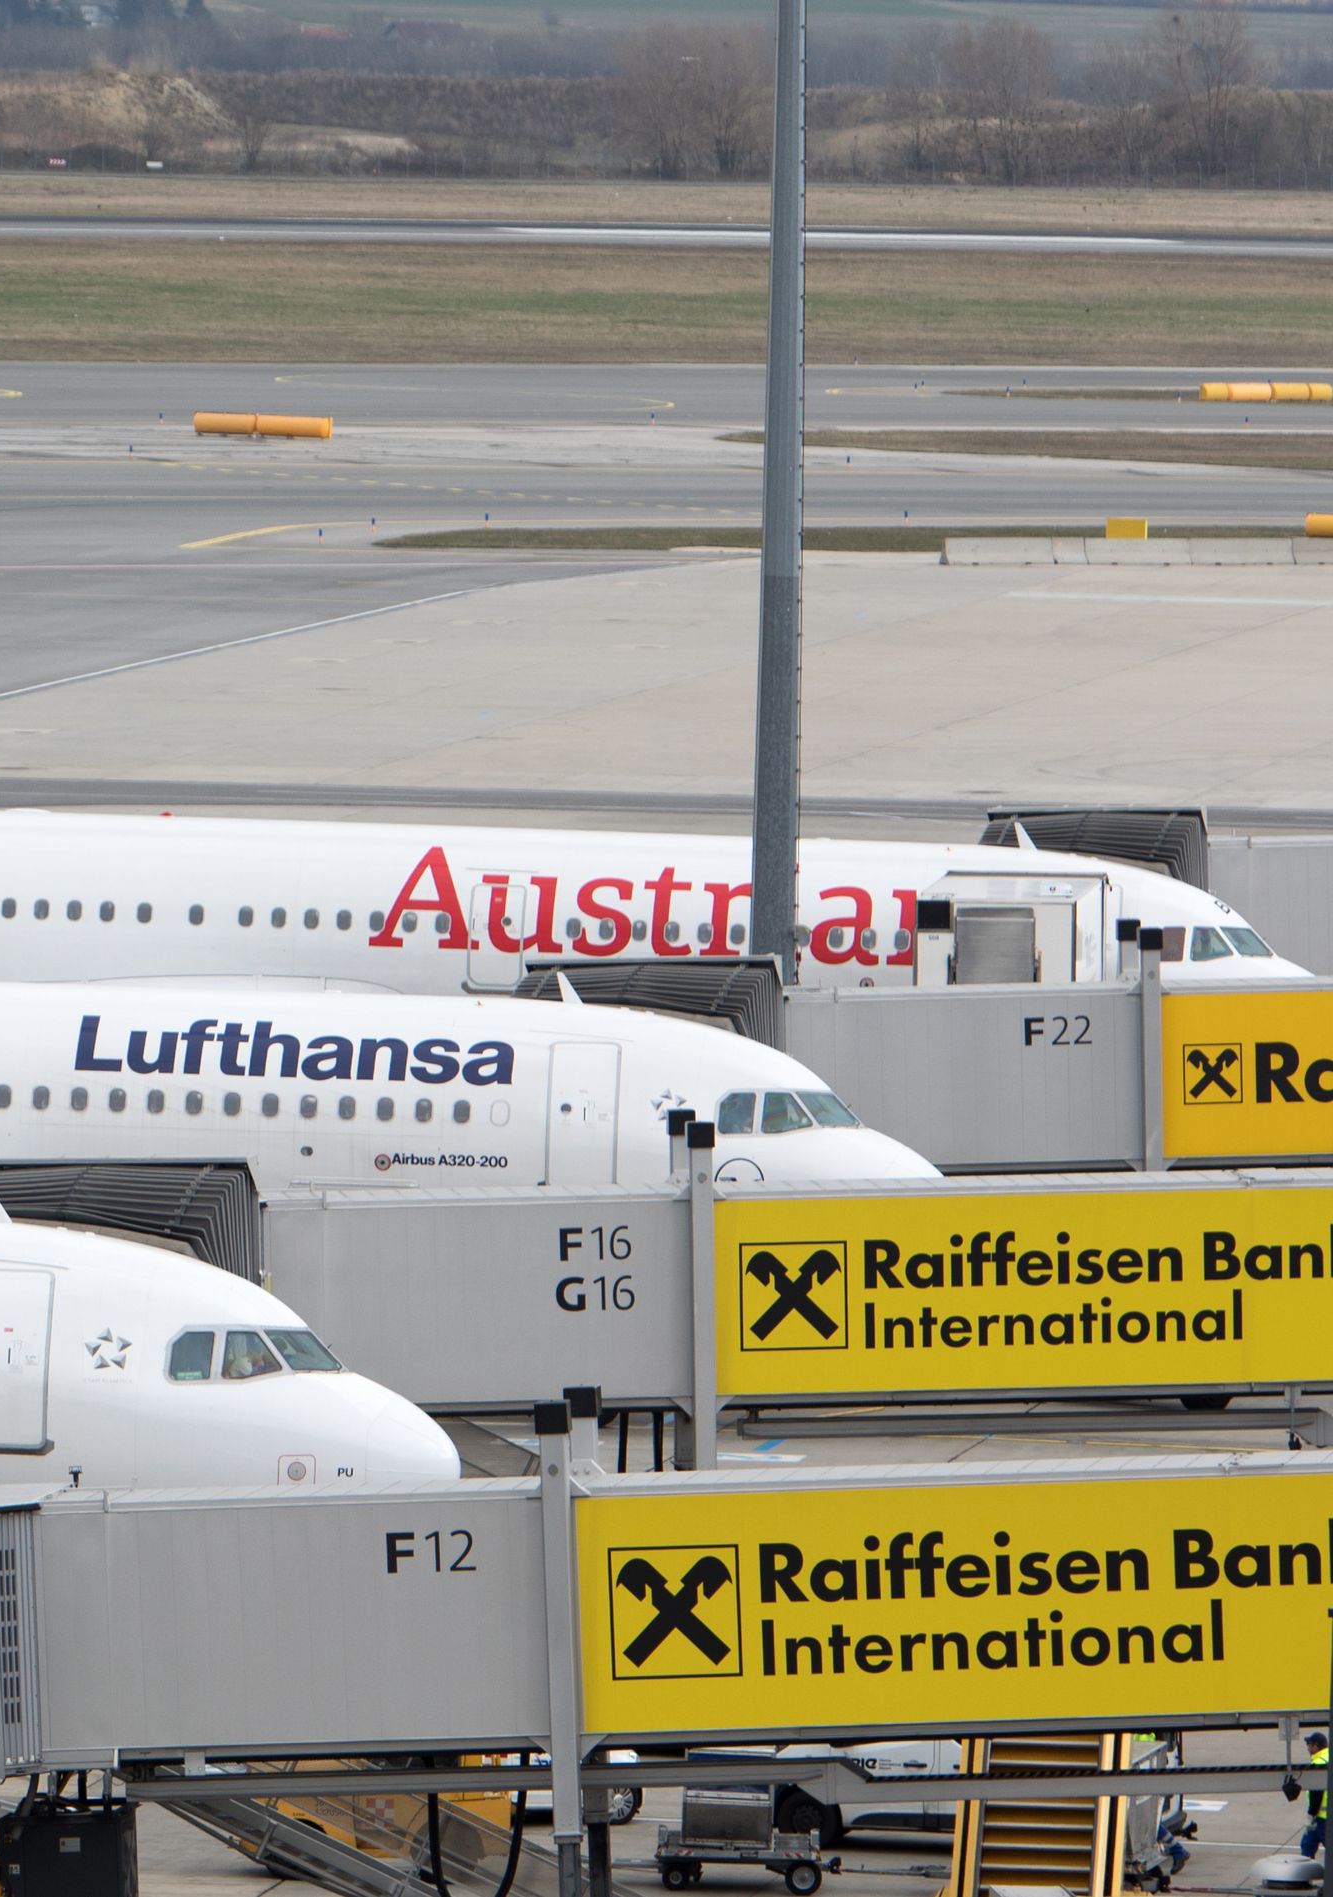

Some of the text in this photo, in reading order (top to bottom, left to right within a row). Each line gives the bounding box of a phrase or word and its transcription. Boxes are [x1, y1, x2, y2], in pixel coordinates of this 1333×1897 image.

[369, 846, 917, 966] Austra
[74, 1015, 515, 1086] Lufthansa
[391, 1153, 509, 1168] Airbus A320-200
[863, 1224, 1333, 1290] Raiffeisen Ban
[864, 1289, 1243, 1350] International
[337, 1467, 354, 1478] PU
[758, 1519, 1333, 1604] Raiffeisen Ban
[760, 1598, 1224, 1677] International
